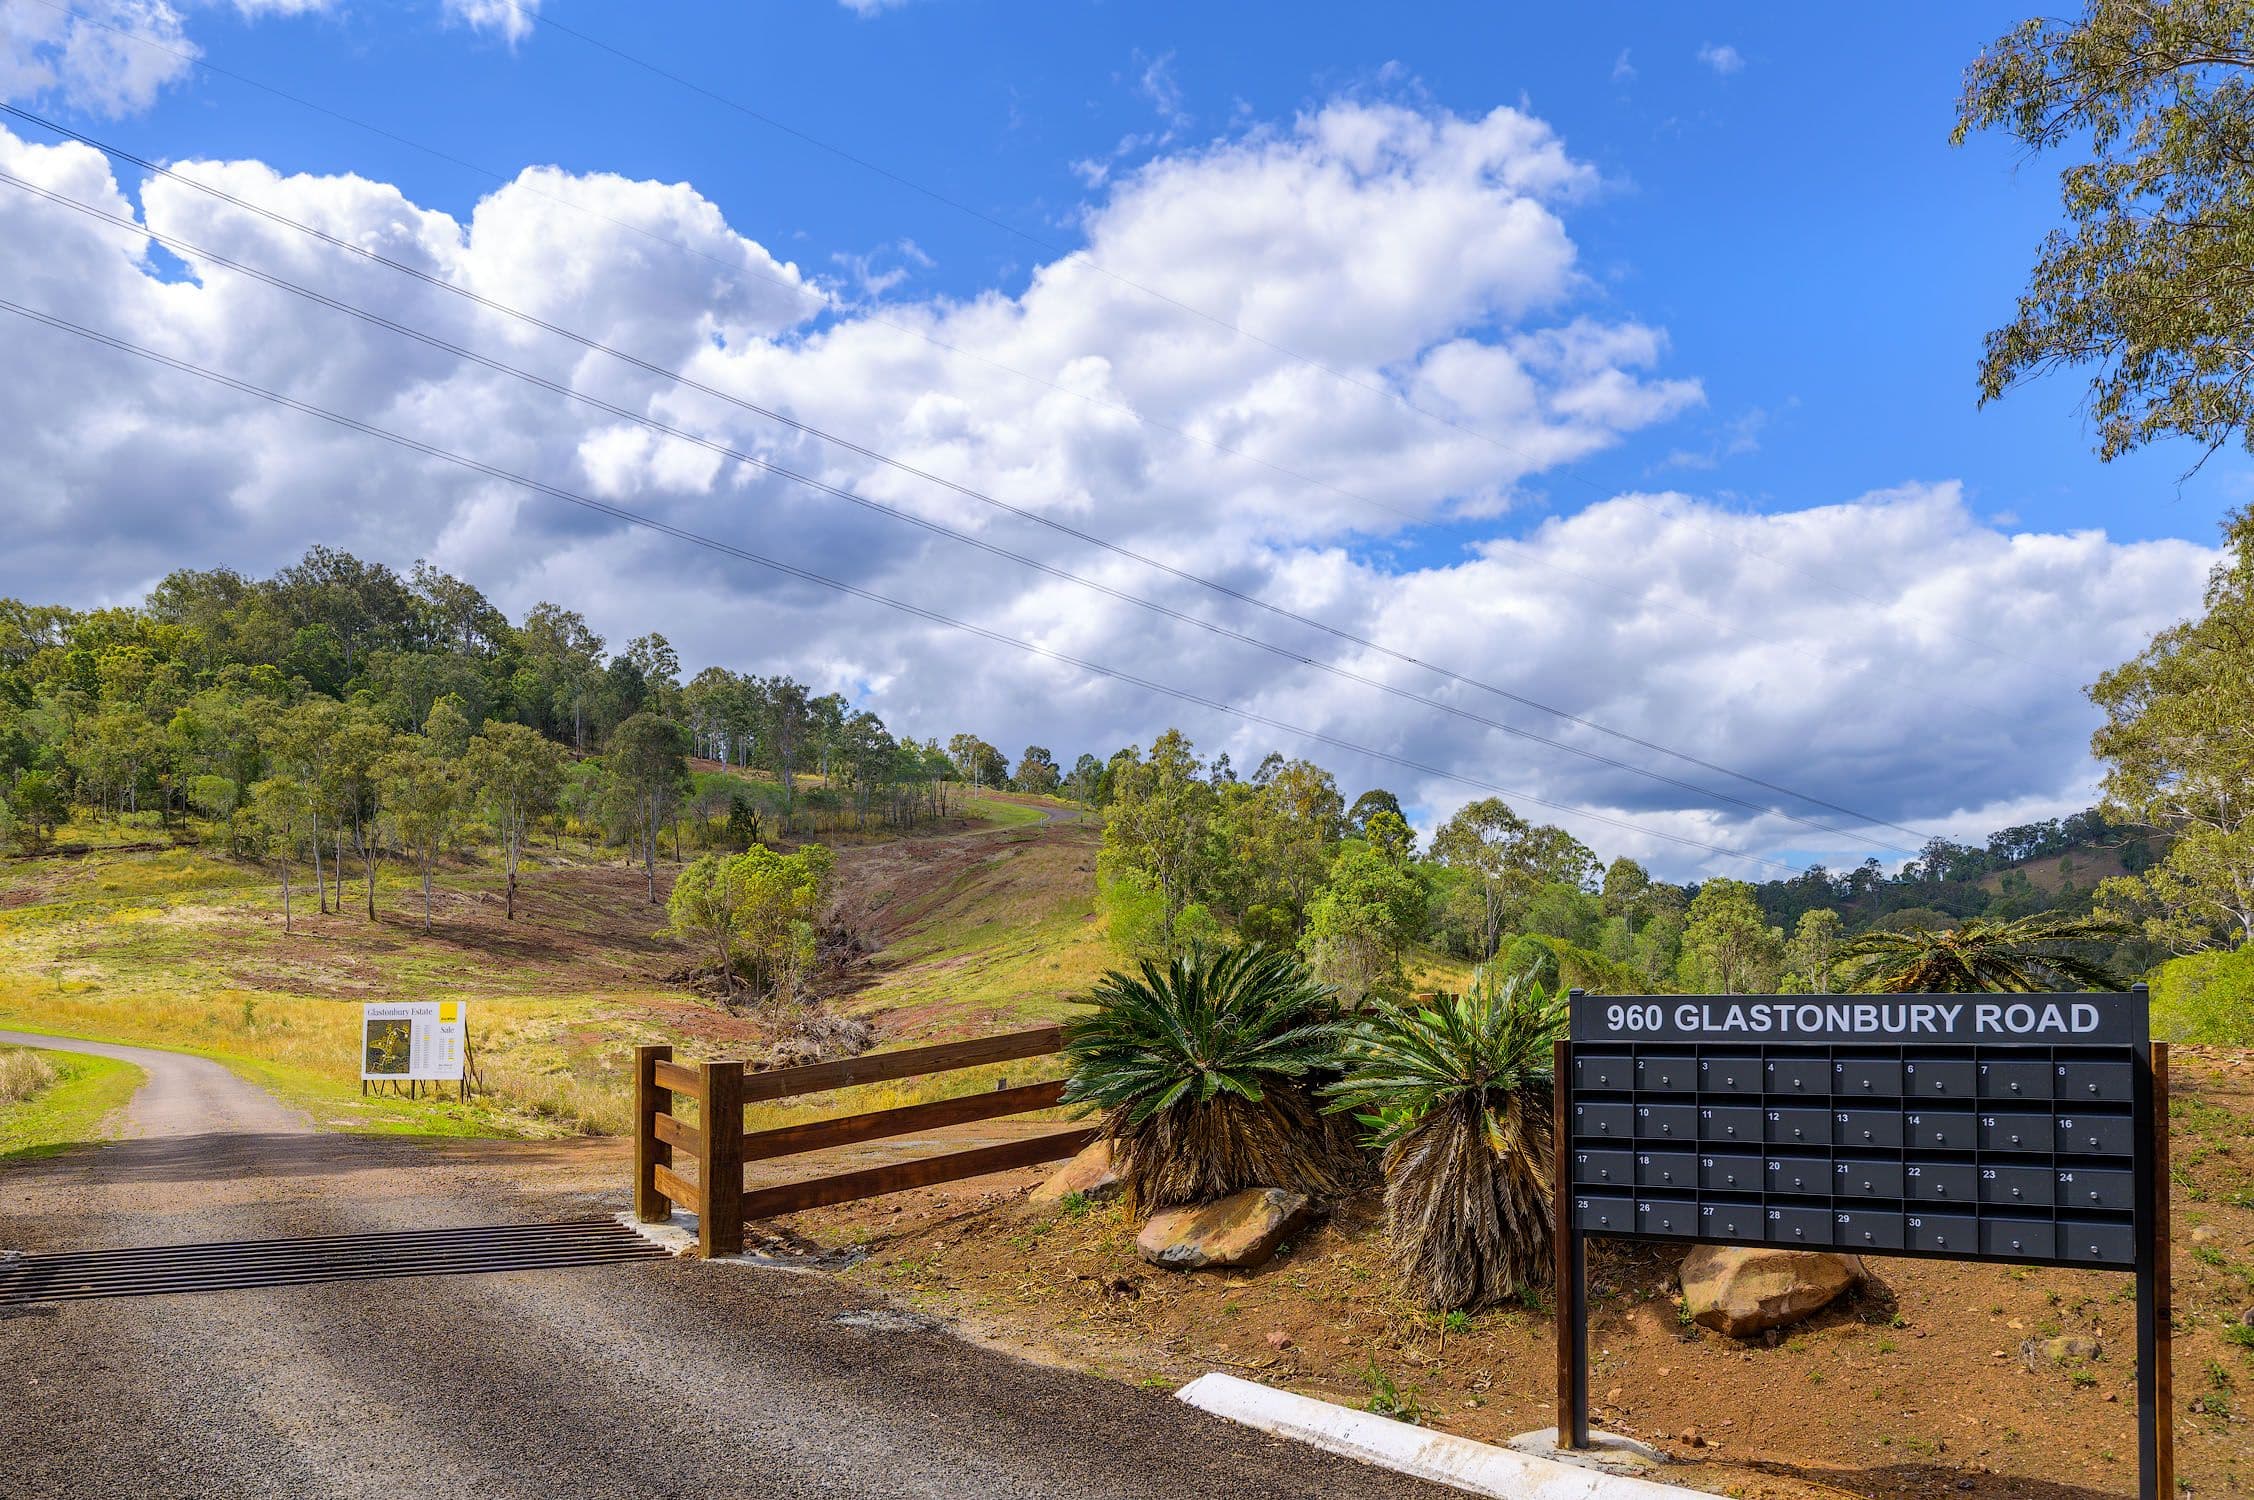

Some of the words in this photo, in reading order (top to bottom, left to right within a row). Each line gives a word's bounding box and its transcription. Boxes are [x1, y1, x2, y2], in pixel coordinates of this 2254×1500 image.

[367, 1007, 409, 1017] Glastonbury
[411, 1007, 433, 1016] Estate
[1607, 1005, 1662, 1031] 960
[1675, 1005, 1963, 1032] GLASTONBURY
[1976, 1004, 2099, 1032] ROAD
[440, 1025, 455, 1033] Sale
[1638, 1061, 1644, 1069] 2
[1702, 1063, 1708, 1071] 3
[1767, 1064, 1774, 1072] 4
[1836, 1064, 1842, 1073] 5
[1907, 1065, 1913, 1074] 6
[1980, 1066, 1987, 1075] 7
[2058, 1067, 2065, 1076] 8
[1577, 1107, 1582, 1115] 9
[1638, 1109, 1649, 1117] 10
[1702, 1111, 1711, 1119] 11
[1768, 1113, 1779, 1121] 12
[1836, 1114, 1848, 1123] 13
[1907, 1116, 1920, 1125] 14
[1982, 1118, 1995, 1127] 15
[2059, 1120, 2072, 1129] 16
[1577, 1155, 1587, 1164] 17
[1639, 1157, 1649, 1165] 18
[1702, 1159, 1713, 1168] 19
[1768, 1162, 1780, 1171] 20
[1837, 1165, 1848, 1174] 21
[1908, 1168, 1920, 1177] 22
[1983, 1170, 1995, 1179] 23
[2059, 1173, 2073, 1183] 24
[1577, 1201, 1588, 1209] 25
[1639, 1204, 1650, 1213] 26
[1703, 1207, 1714, 1216] 27
[1769, 1211, 1780, 1220] 28
[1837, 1215, 1849, 1223] 29
[1908, 1218, 1921, 1228] 30
